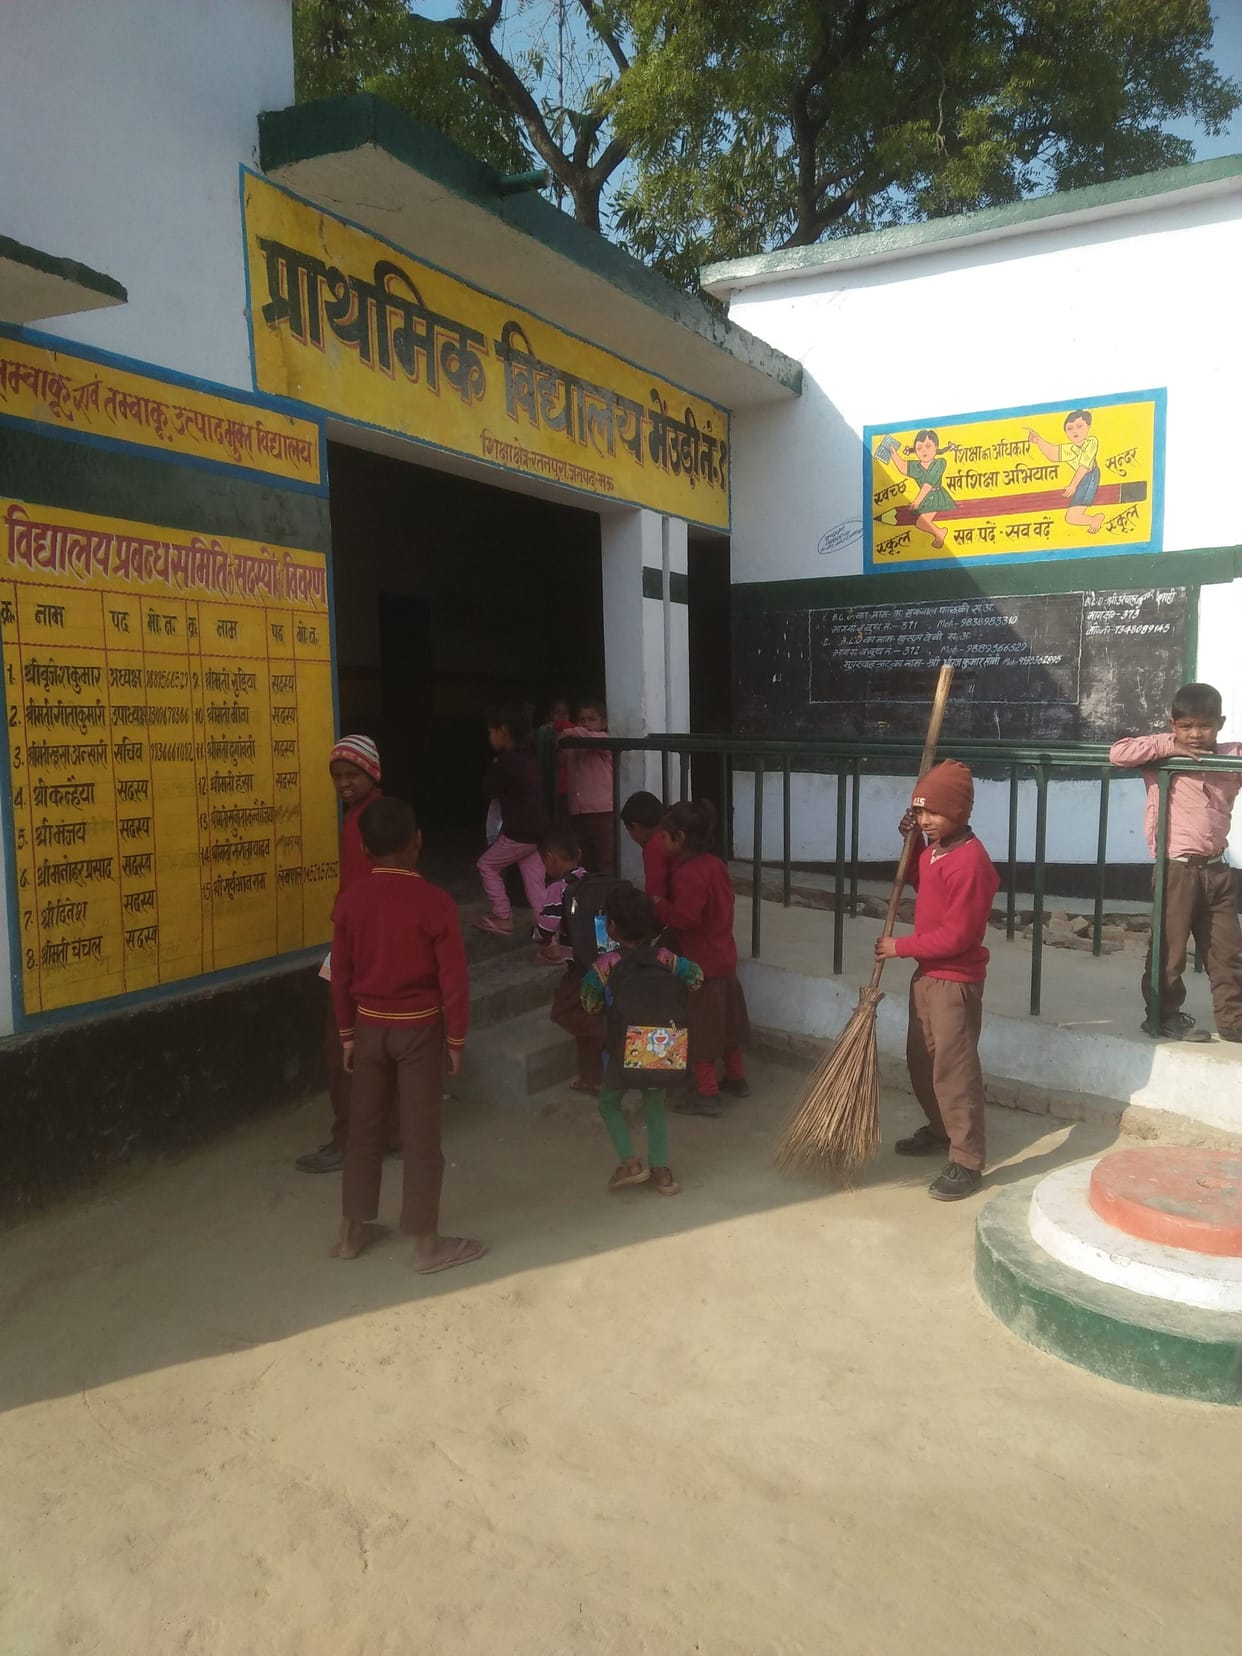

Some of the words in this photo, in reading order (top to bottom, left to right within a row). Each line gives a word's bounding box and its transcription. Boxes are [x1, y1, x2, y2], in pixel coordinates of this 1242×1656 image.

[256, 234, 489, 407] प्राथमिक
[493, 320, 648, 468] विद्यालय
[255, 419, 312, 471] विद्यालय
[954, 442, 982, 465] शिक्षा
[991, 438, 1031, 460] अधिकार
[945, 469, 963, 492] सर्व
[964, 469, 999, 490] शिक्षा
[1001, 463, 1060, 488] अभियान
[1105, 447, 1137, 477] सुन्दर
[1105, 504, 1140, 534] स्कूल
[5, 503, 113, 586] विद्यालय
[876, 530, 912, 556] स्कूल
[35, 603, 65, 628] नाम
[109, 610, 130, 634] पद
[216, 619, 239, 641] नाम
[271, 623, 288, 646] पद
[109, 667, 142, 689] अध्यक्ष
[271, 674, 296, 696] सदस्य
[10, 705, 22, 727] 2.
[272, 706, 297, 728] सदस्य
[13, 746, 25, 769] 3.
[114, 736, 144, 766] सचिव
[33, 777, 49, 808] श्री
[118, 779, 150, 804] सदस्य
[35, 816, 53, 848] श्री
[119, 816, 153, 842] सदस्य
[37, 857, 52, 888] श्री
[122, 852, 154, 879] सदस्य
[42, 900, 56, 930] श्री
[123, 889, 158, 916] सदस्य
[26, 948, 39, 971] 8.
[125, 924, 160, 952] सदस्य
